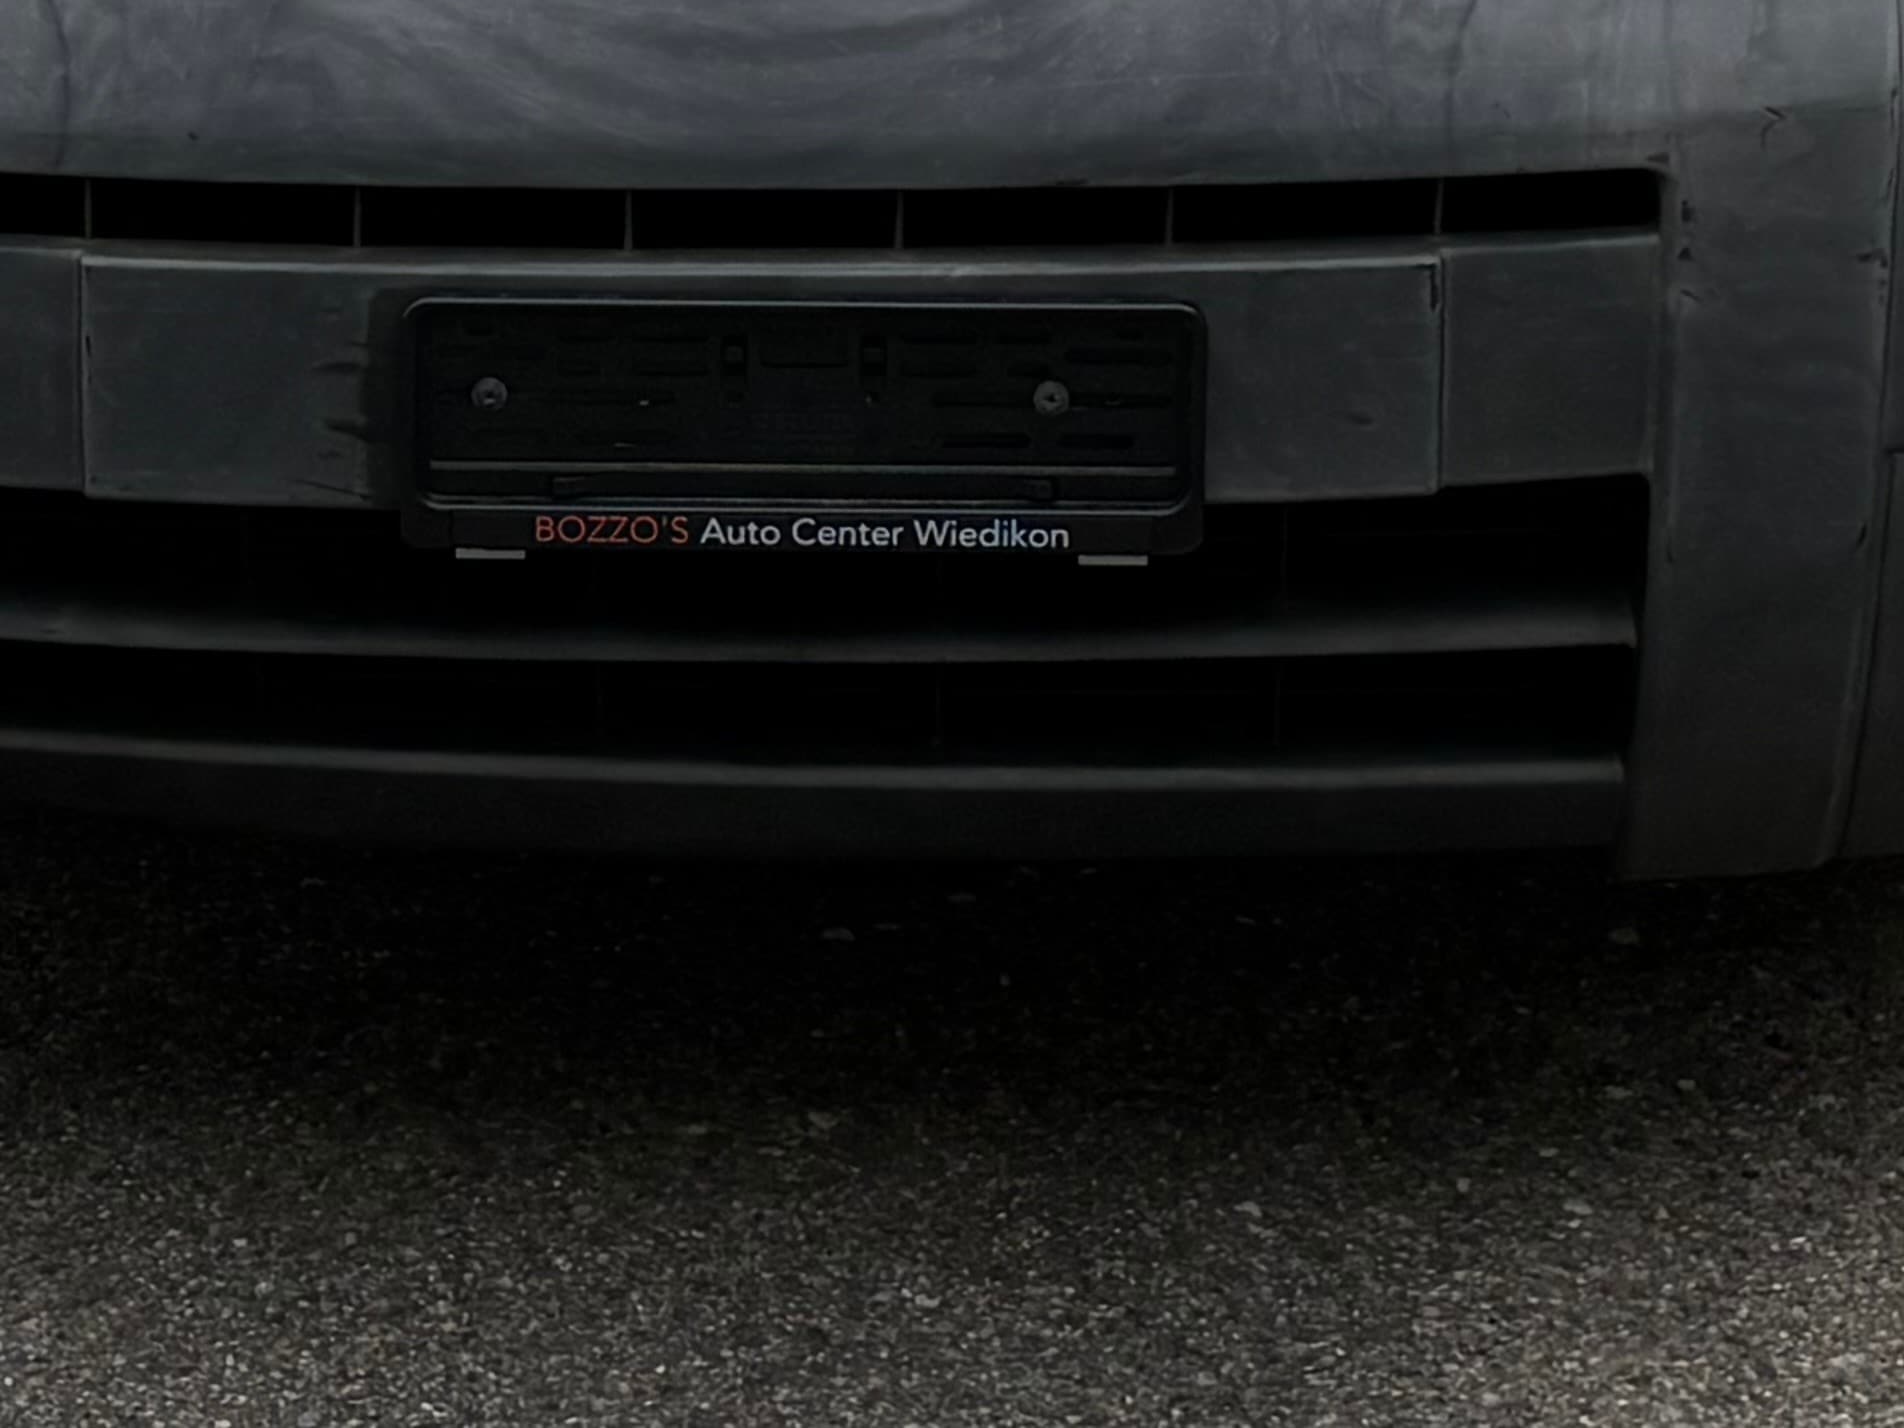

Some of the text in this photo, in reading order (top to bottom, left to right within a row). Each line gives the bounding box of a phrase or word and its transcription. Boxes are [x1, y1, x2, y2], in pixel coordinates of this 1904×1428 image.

[535, 515, 1070, 549] BOZZO'S Auto Center Wiedikon
